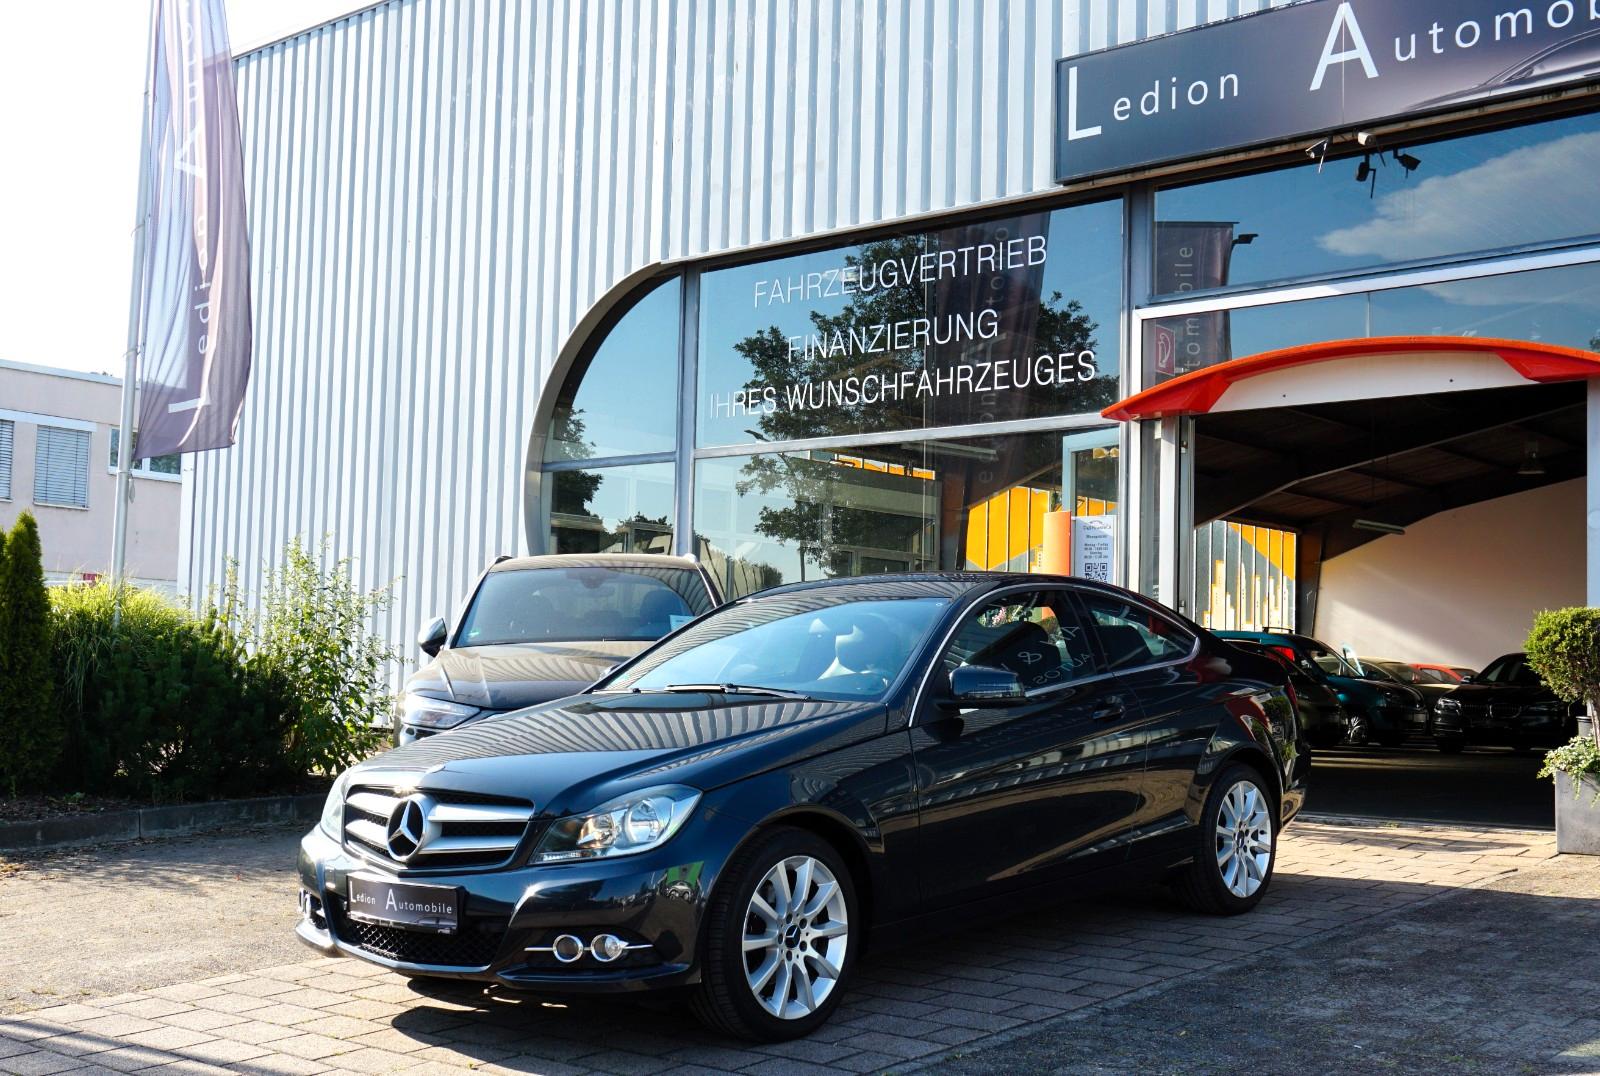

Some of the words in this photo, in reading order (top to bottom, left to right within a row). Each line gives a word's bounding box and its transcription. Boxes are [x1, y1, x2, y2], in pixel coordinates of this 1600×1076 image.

[1067, 66, 1240, 142] Ledion
[753, 235, 1048, 309] FAHRZEUGVERTRIEB
[787, 309, 999, 364] FINANZIERUNG
[709, 386, 777, 420] IHRES
[785, 350, 1097, 412] WUNSCHFAHRZEUGES
[349, 880, 376, 905] Ledion
[385, 888, 453, 914] Automobile
